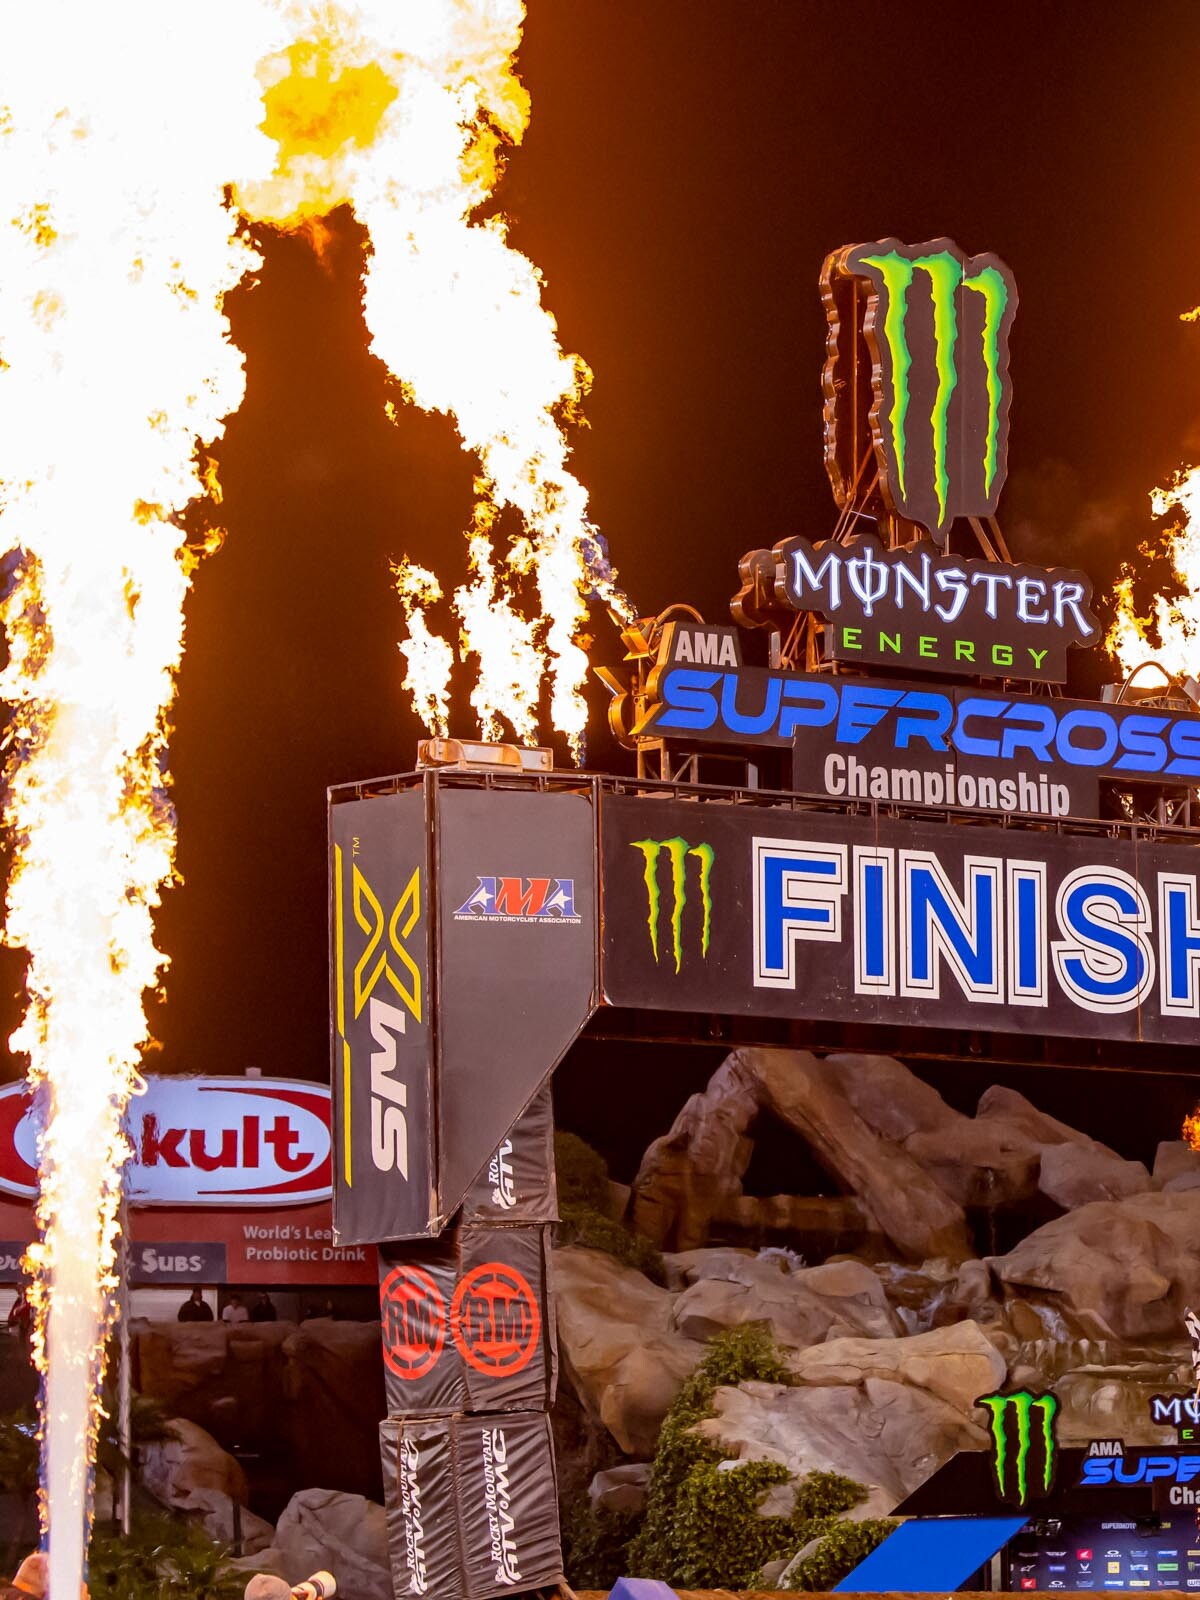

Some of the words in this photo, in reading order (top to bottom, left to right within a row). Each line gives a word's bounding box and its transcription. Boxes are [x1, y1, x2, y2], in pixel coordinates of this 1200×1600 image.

[674, 629, 738, 667] AMA
[843, 628, 1048, 669] ENERGY
[825, 753, 1070, 816] Championship
[453, 876, 582, 917] AMA
[140, 1114, 315, 1172] kult
[246, 1246, 318, 1262] Probiotic
[322, 1246, 366, 1262] Drink
[481, 1428, 498, 1512] MOUNTAIN
[1089, 1441, 1123, 1457] AMA
[405, 1519, 416, 1569] ROCKY
[488, 1512, 503, 1563] ROCKY
